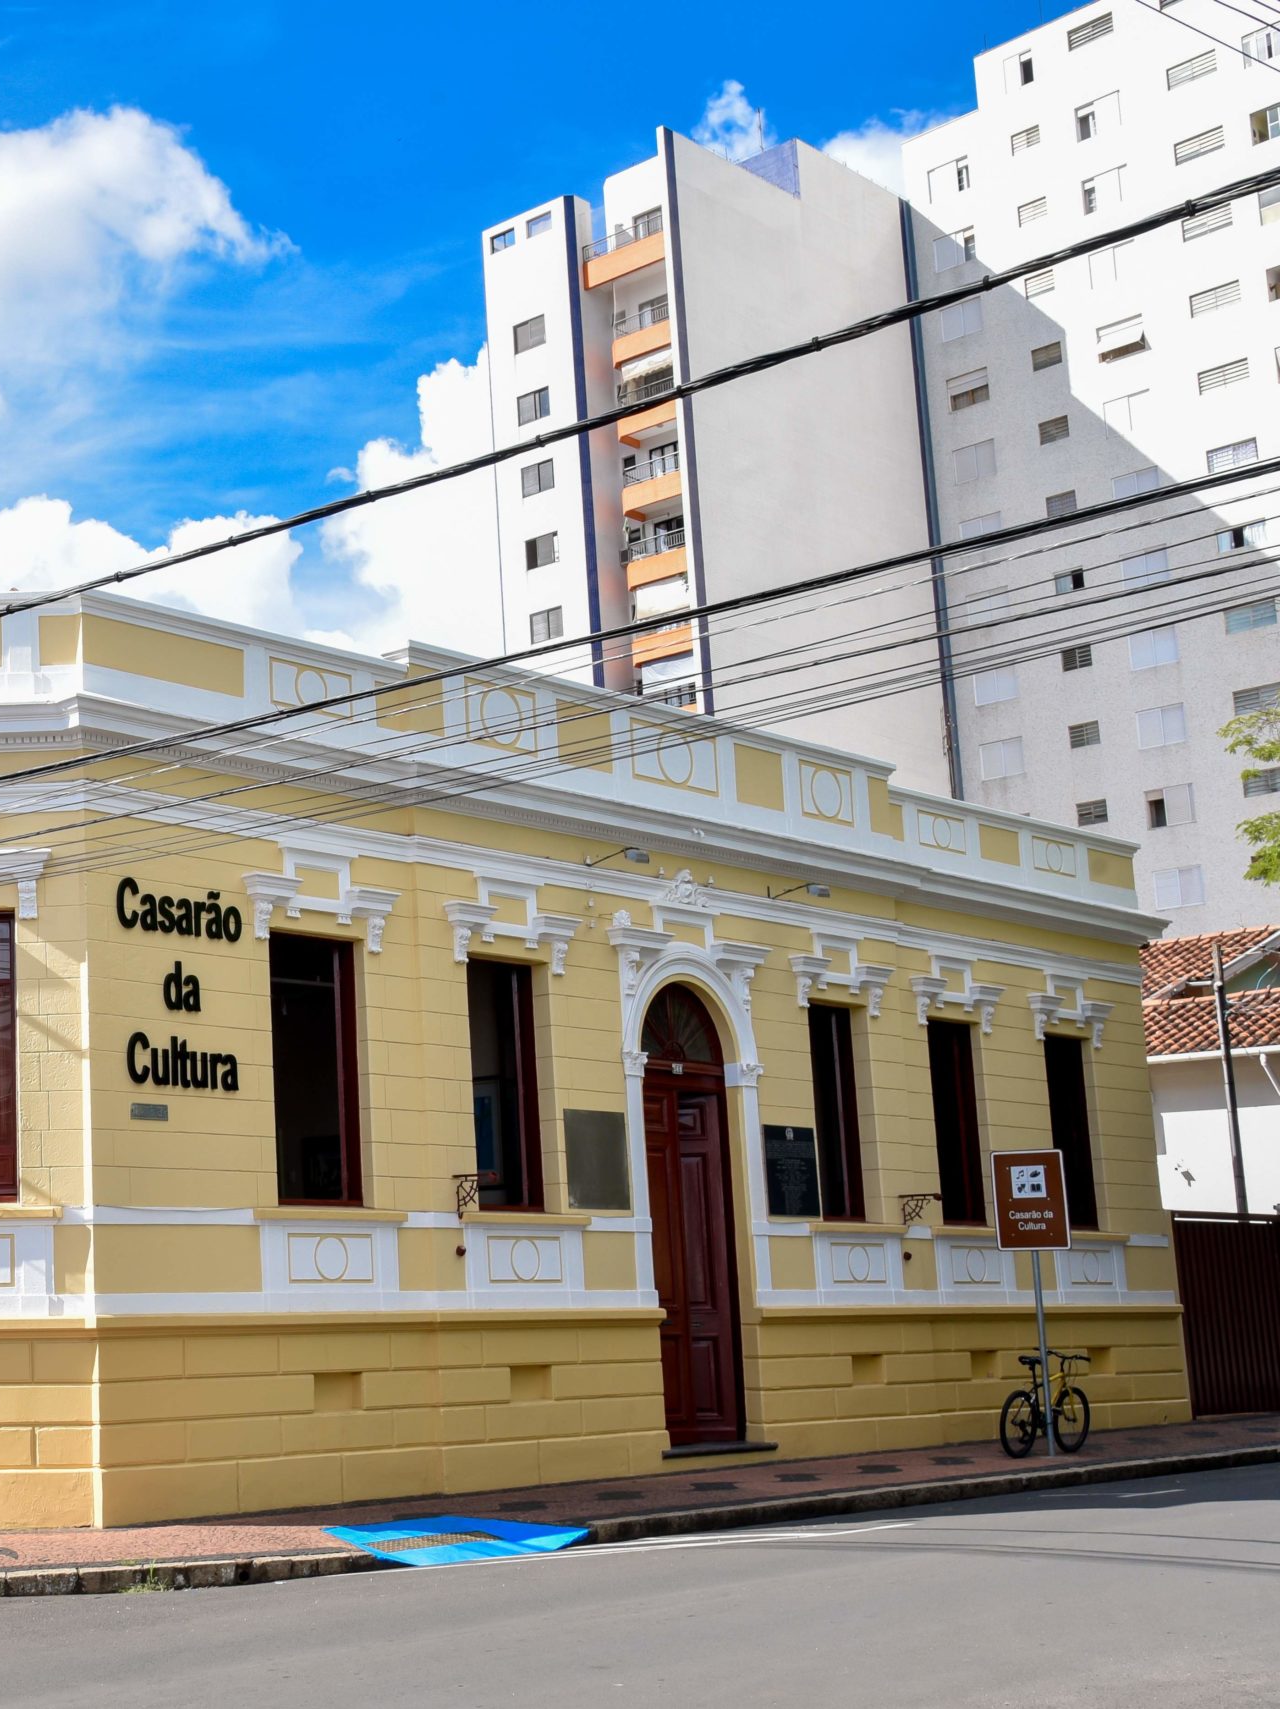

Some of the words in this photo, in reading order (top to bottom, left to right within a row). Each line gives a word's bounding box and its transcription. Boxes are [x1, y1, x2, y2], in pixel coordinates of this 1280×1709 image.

[116, 876, 242, 943] Casarão
[163, 960, 201, 1012] da
[127, 1031, 239, 1091] Cultura
[1009, 1210, 1041, 1219] Casarão
[1043, 1210, 1053, 1218] da
[1018, 1221, 1046, 1230] Cultura
